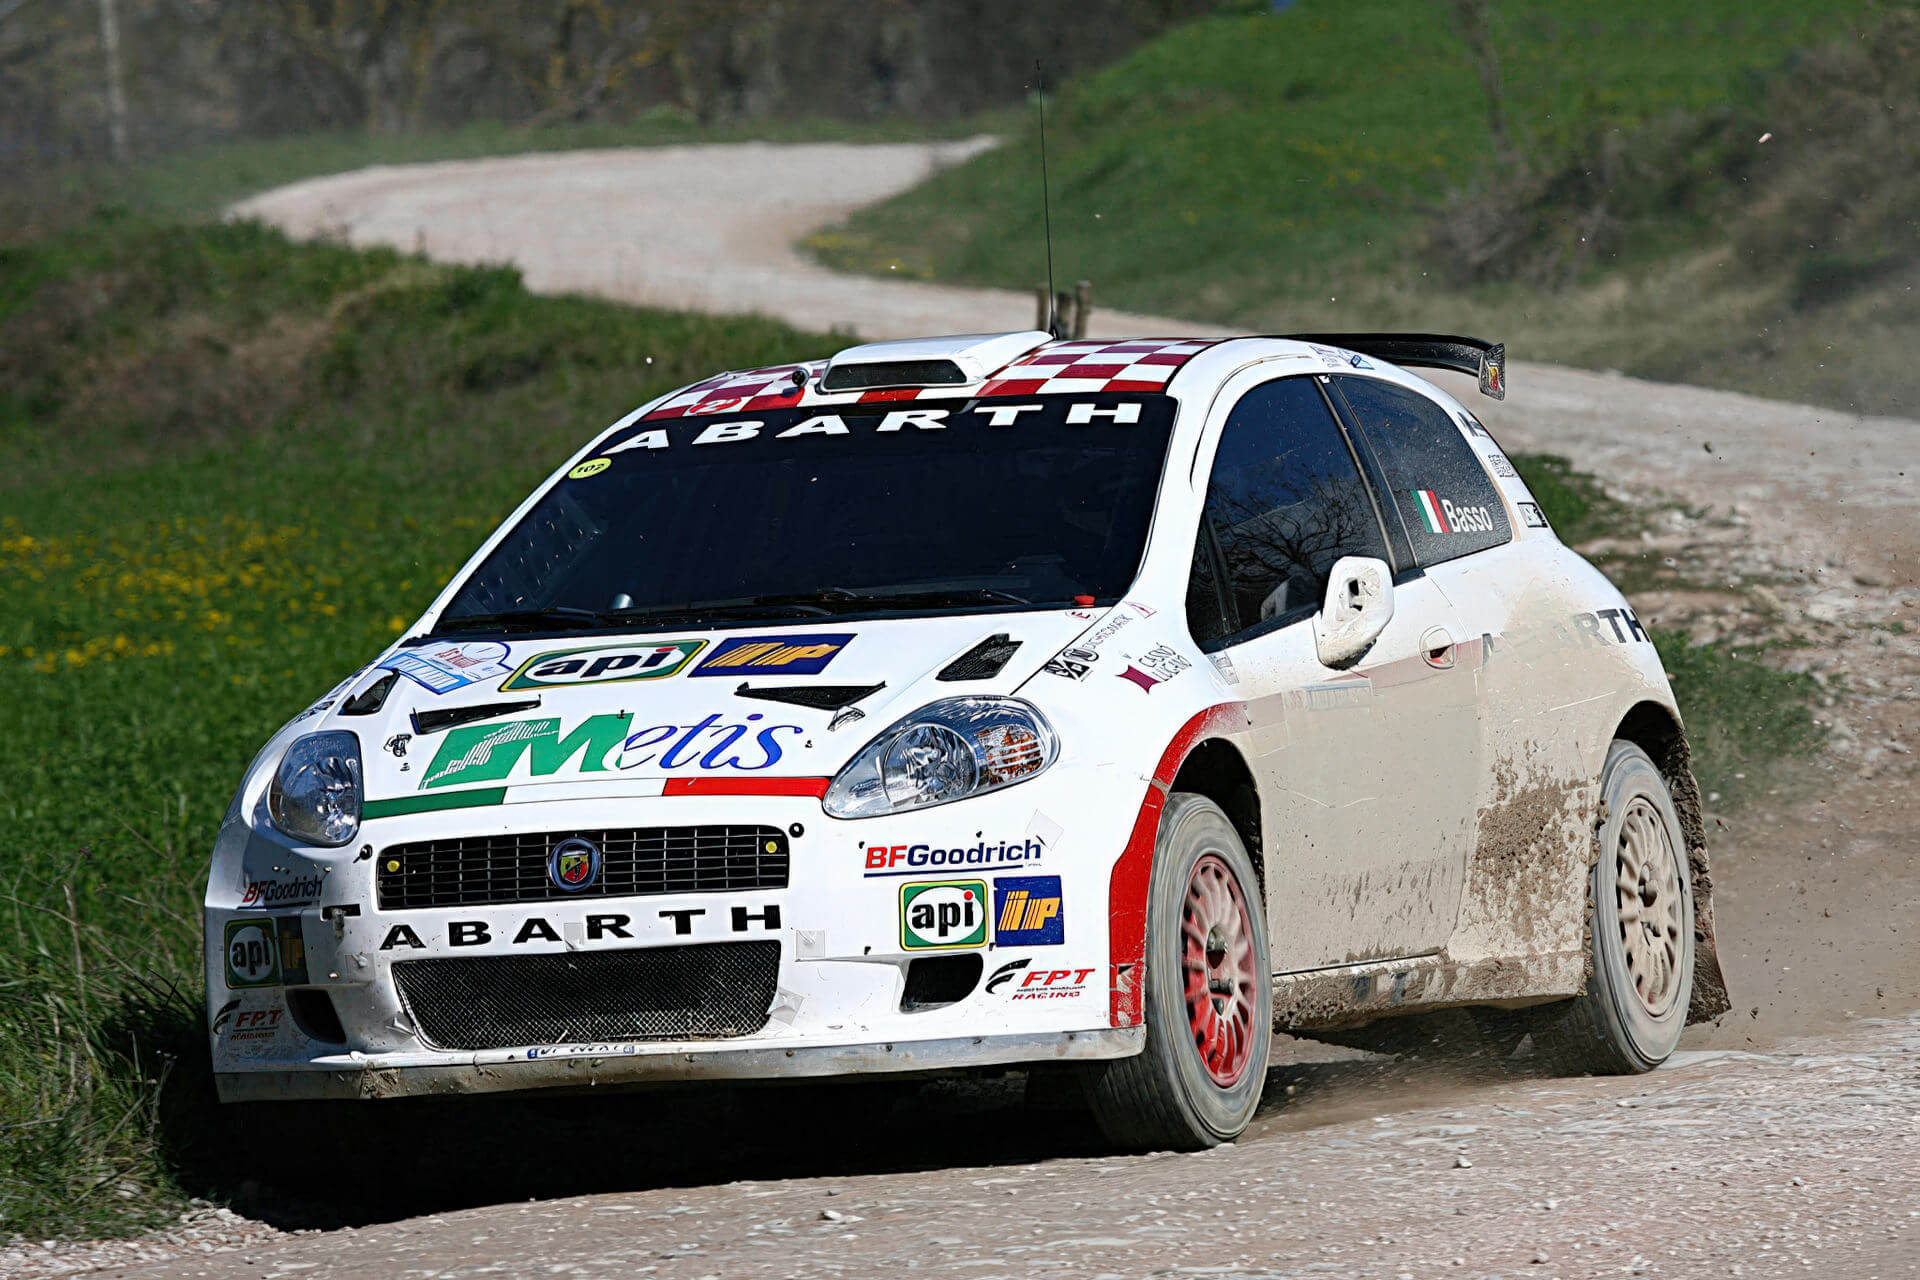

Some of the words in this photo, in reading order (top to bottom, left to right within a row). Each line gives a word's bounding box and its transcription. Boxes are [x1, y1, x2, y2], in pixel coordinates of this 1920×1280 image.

[600, 402, 1142, 455] ABARTH
[1441, 499, 1493, 532] Basso
[533, 645, 681, 679] api
[419, 712, 803, 790] Metis
[865, 839, 1041, 869] BFGoodrich
[243, 876, 323, 904] BFGoodrich
[378, 904, 783, 950] ABARTH
[911, 890, 974, 937] api
[232, 929, 271, 976] api
[1021, 968, 1096, 988] FPT
[234, 1008, 285, 1028] FPT
